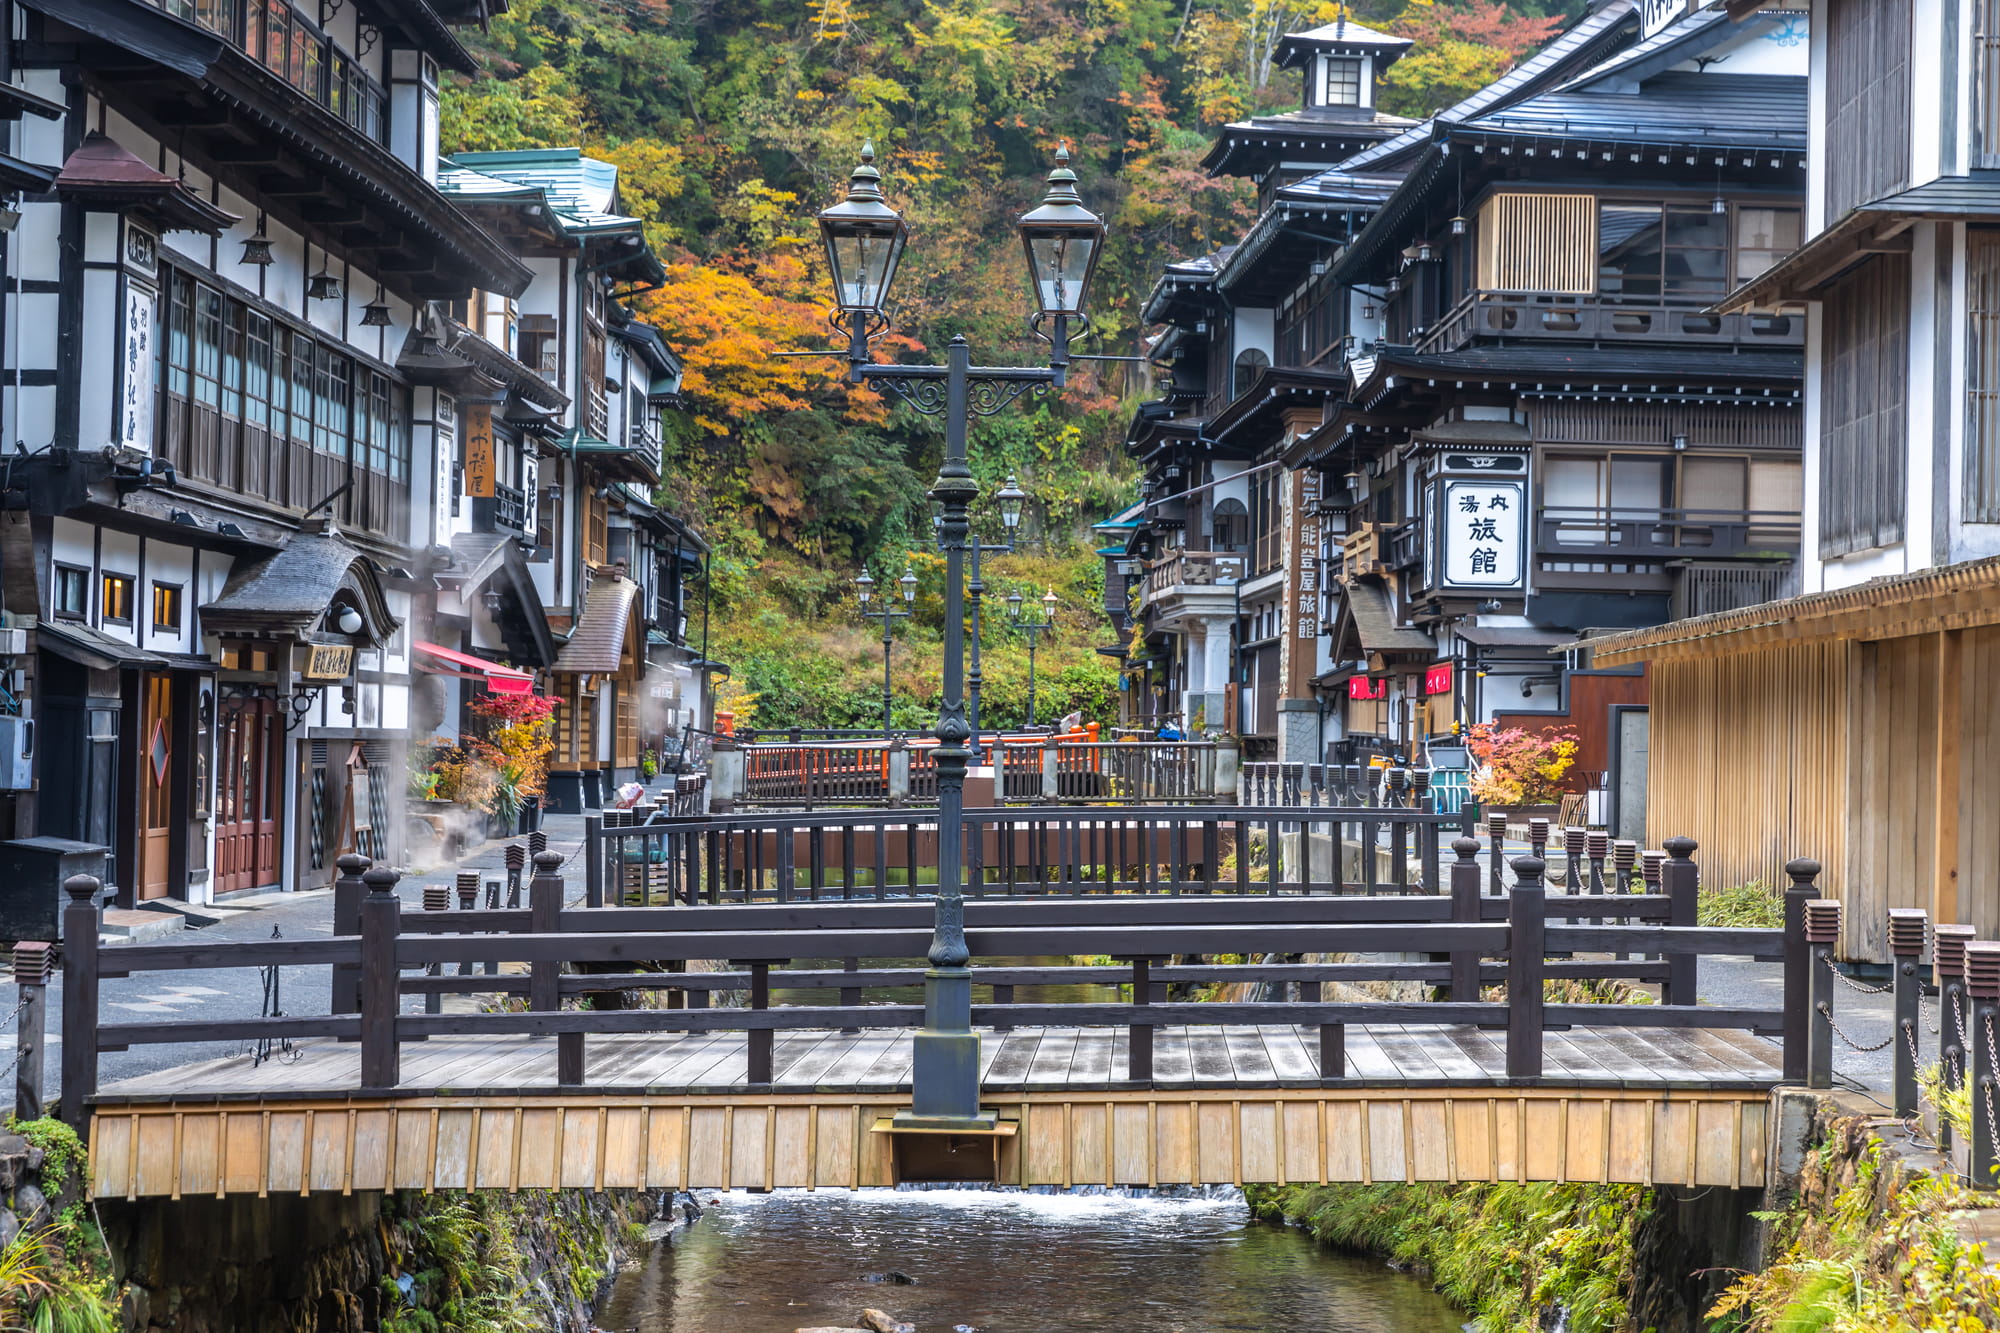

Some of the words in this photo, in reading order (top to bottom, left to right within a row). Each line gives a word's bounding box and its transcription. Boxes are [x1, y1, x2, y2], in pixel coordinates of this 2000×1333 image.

[1298, 523, 1317, 638] 能登屋旅館
[1468, 517, 1503, 575] 旅館
